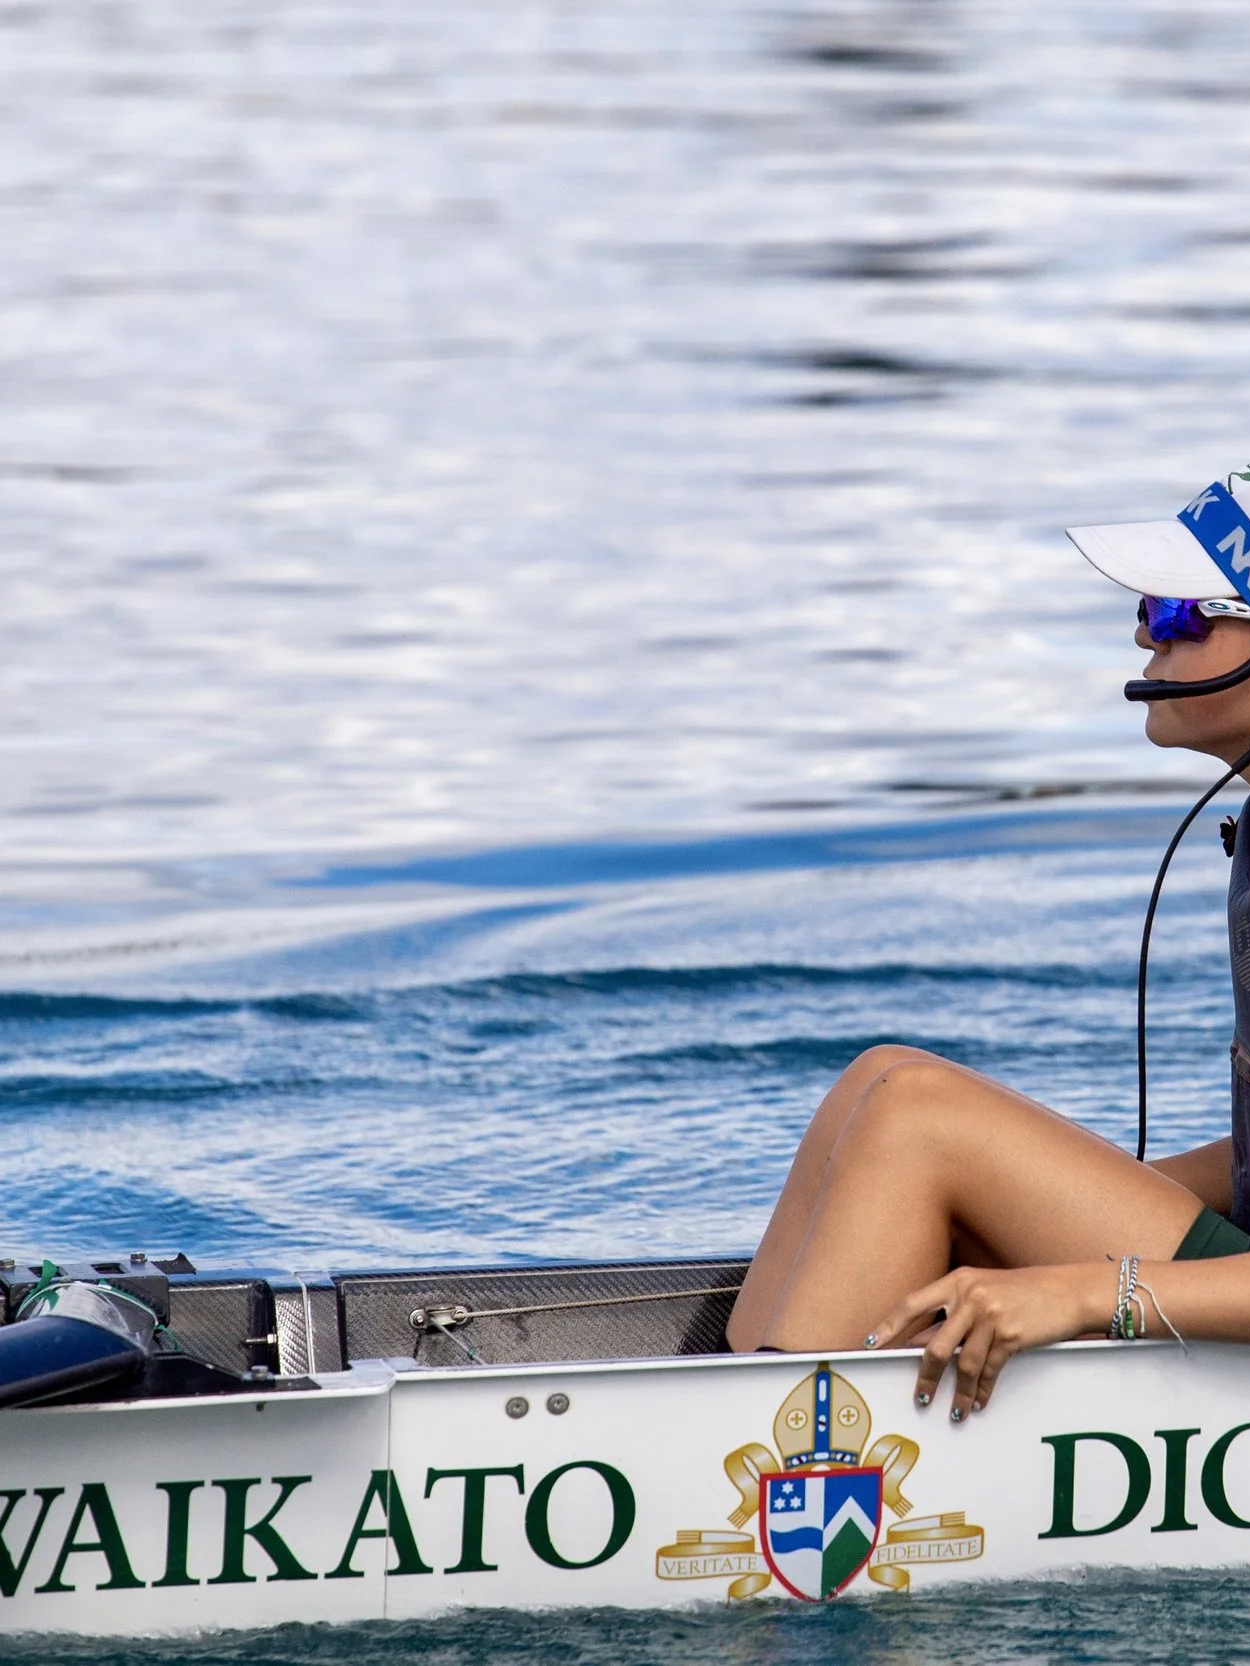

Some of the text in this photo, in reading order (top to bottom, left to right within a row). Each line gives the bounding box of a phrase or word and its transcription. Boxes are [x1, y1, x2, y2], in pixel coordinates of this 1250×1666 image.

[1187, 489, 1219, 520] K
[663, 1540, 977, 1576] VERITATE FIDELITATE
